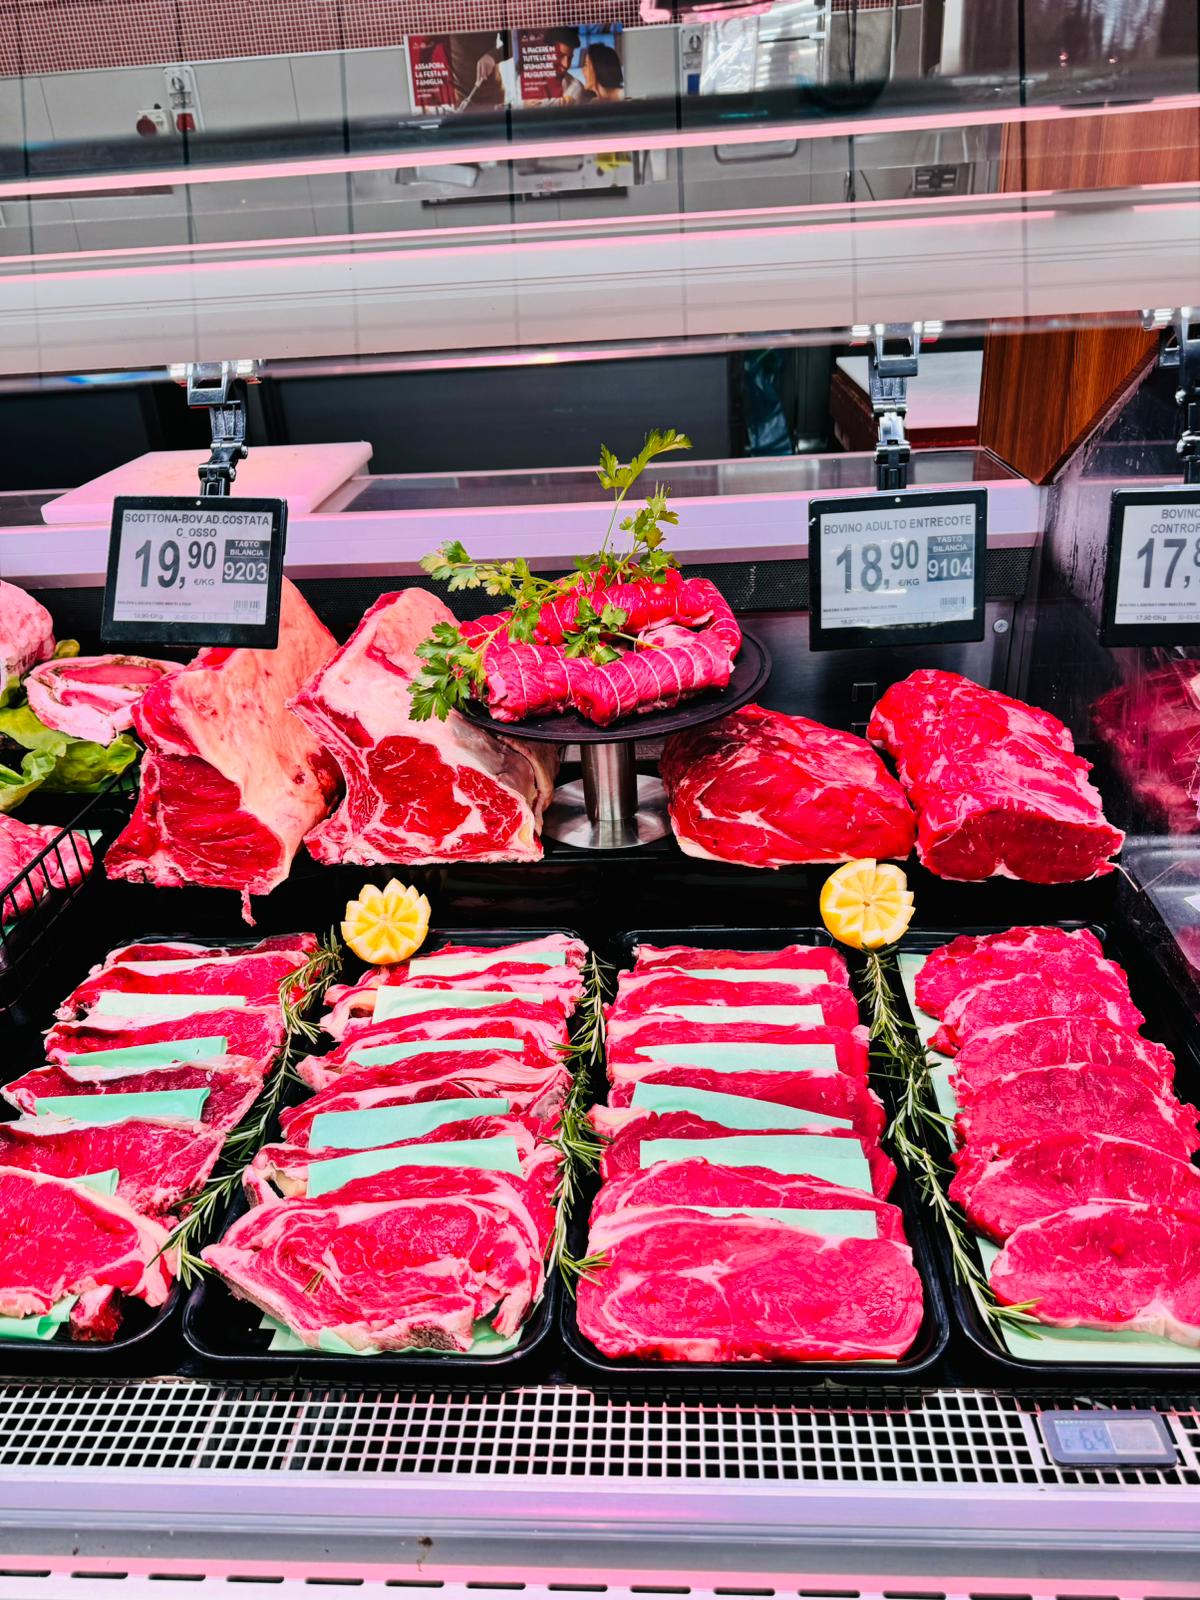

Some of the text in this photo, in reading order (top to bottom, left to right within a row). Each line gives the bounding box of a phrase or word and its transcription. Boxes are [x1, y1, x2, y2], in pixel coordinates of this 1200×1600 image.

[824, 515, 972, 535] BOVINO ADULTO ENTRECOTE
[932, 544, 968, 553] BILANCIA
[224, 562, 268, 581] 9203
[927, 557, 972, 579] 9104
